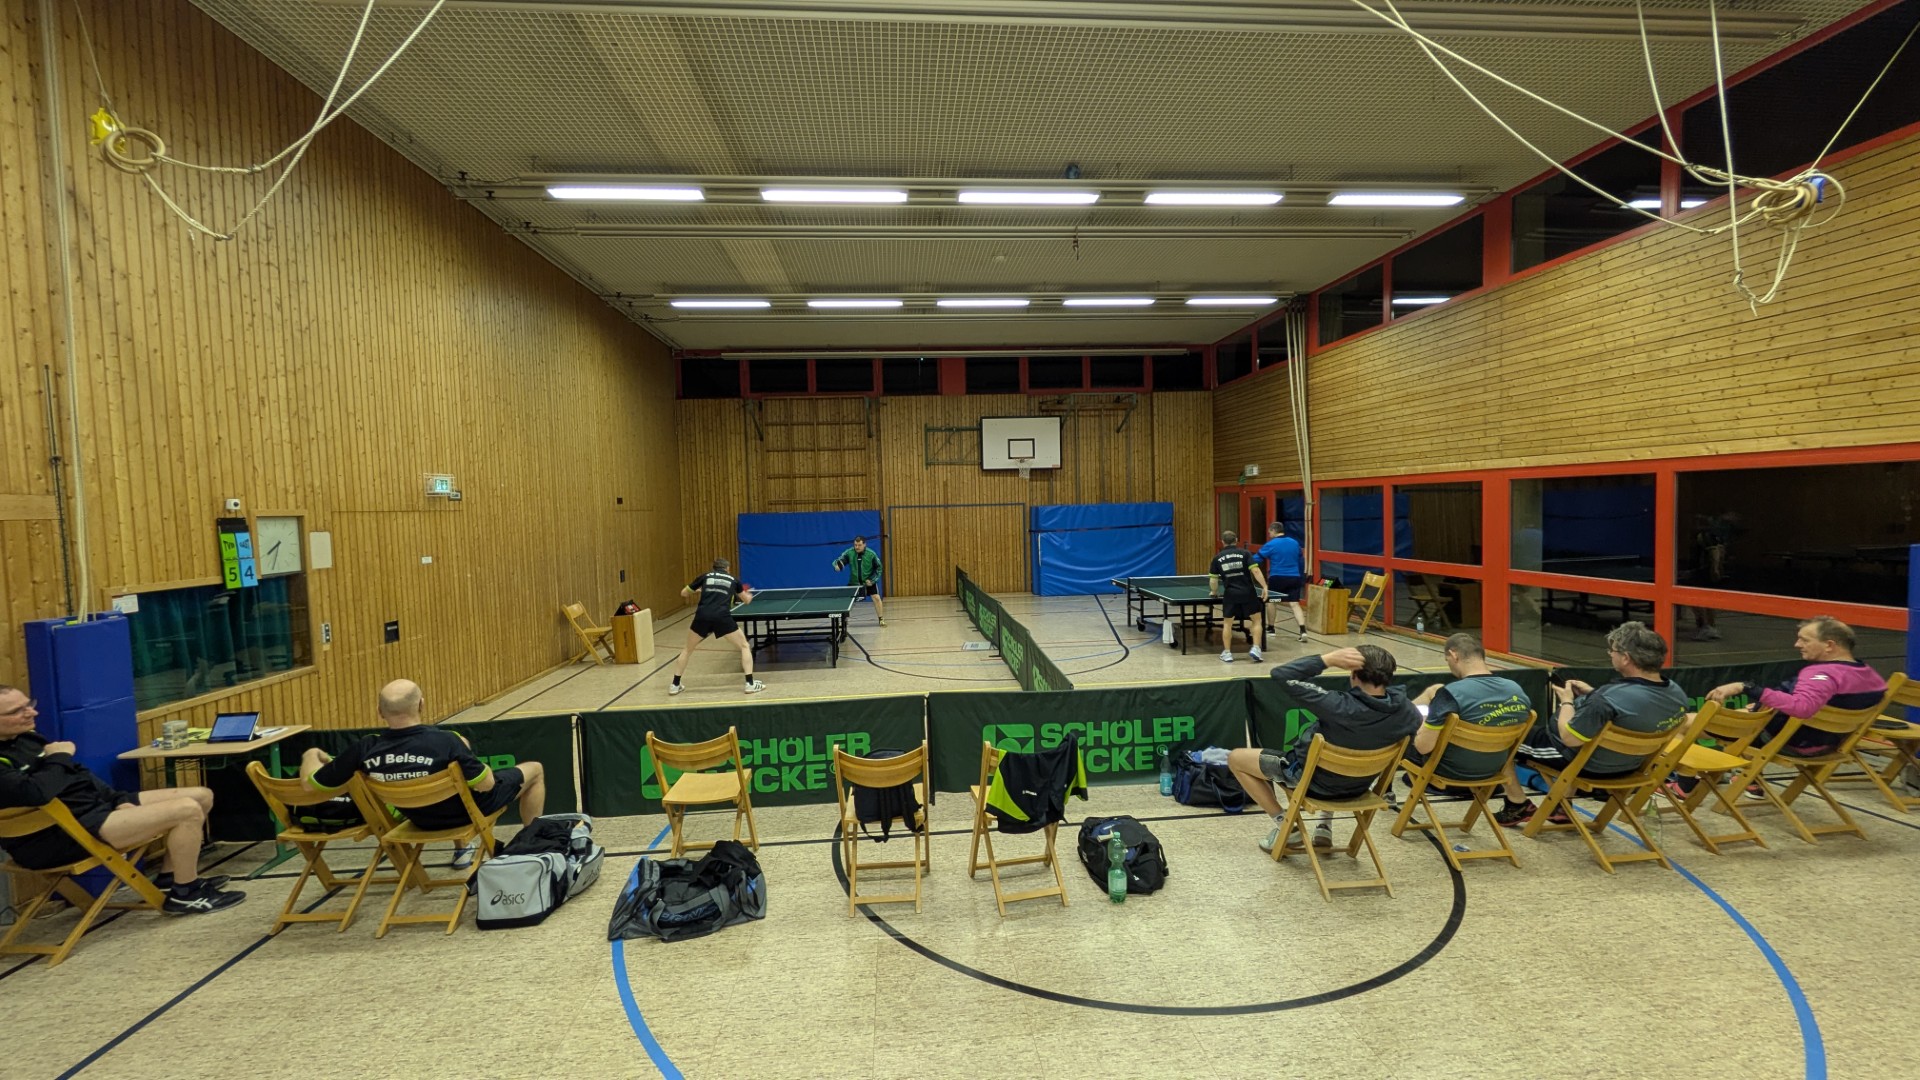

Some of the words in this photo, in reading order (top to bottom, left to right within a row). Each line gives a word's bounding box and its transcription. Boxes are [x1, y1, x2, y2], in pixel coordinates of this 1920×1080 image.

[229, 567, 238, 582] 5
[244, 565, 254, 580] 4
[1040, 715, 1195, 748] SCHÖLER
[718, 731, 871, 766] CHÖLER
[363, 756, 381, 769] TV
[385, 752, 434, 766] Belsen
[499, 891, 525, 906] asics
